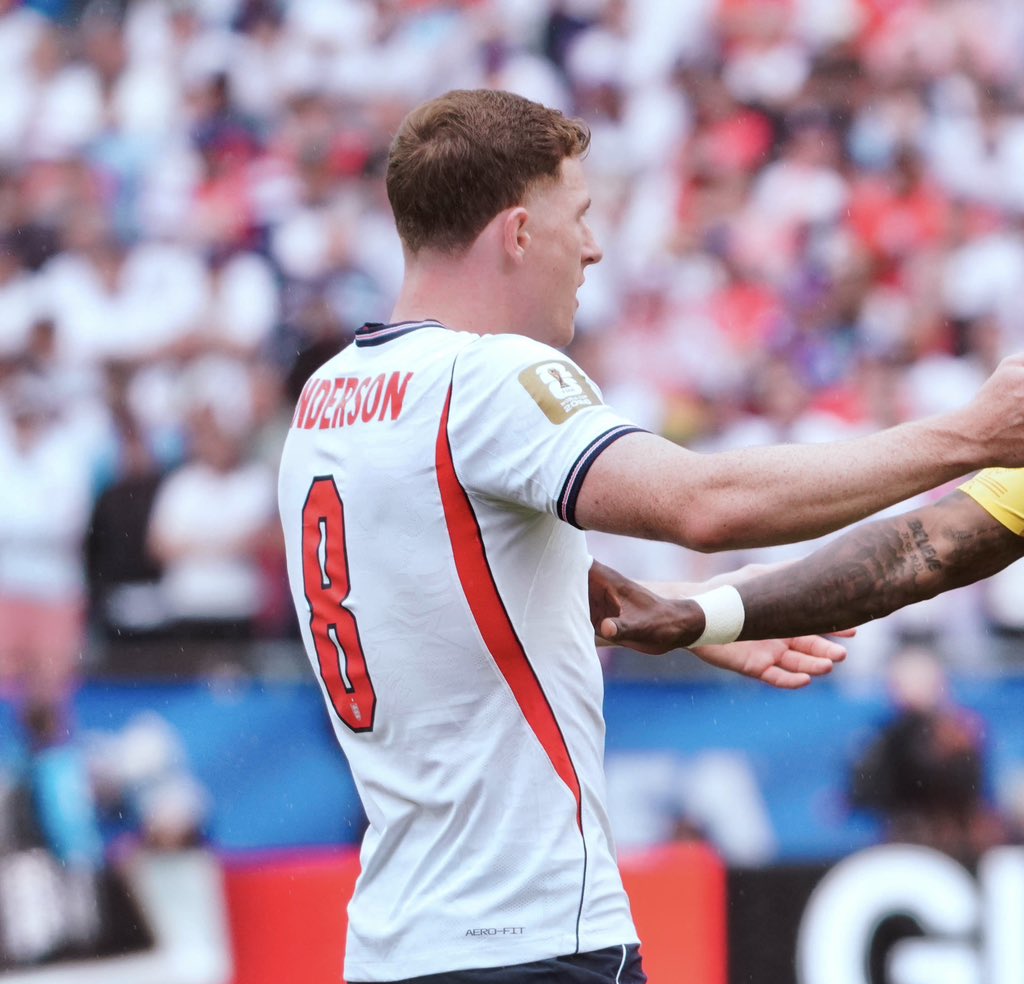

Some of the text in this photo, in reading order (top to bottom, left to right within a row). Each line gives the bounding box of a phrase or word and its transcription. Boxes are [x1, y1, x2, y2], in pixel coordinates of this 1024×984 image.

[290, 370, 414, 430] NDERSON
[302, 474, 377, 733] 8
[465, 926, 526, 937] AERO-FIT
